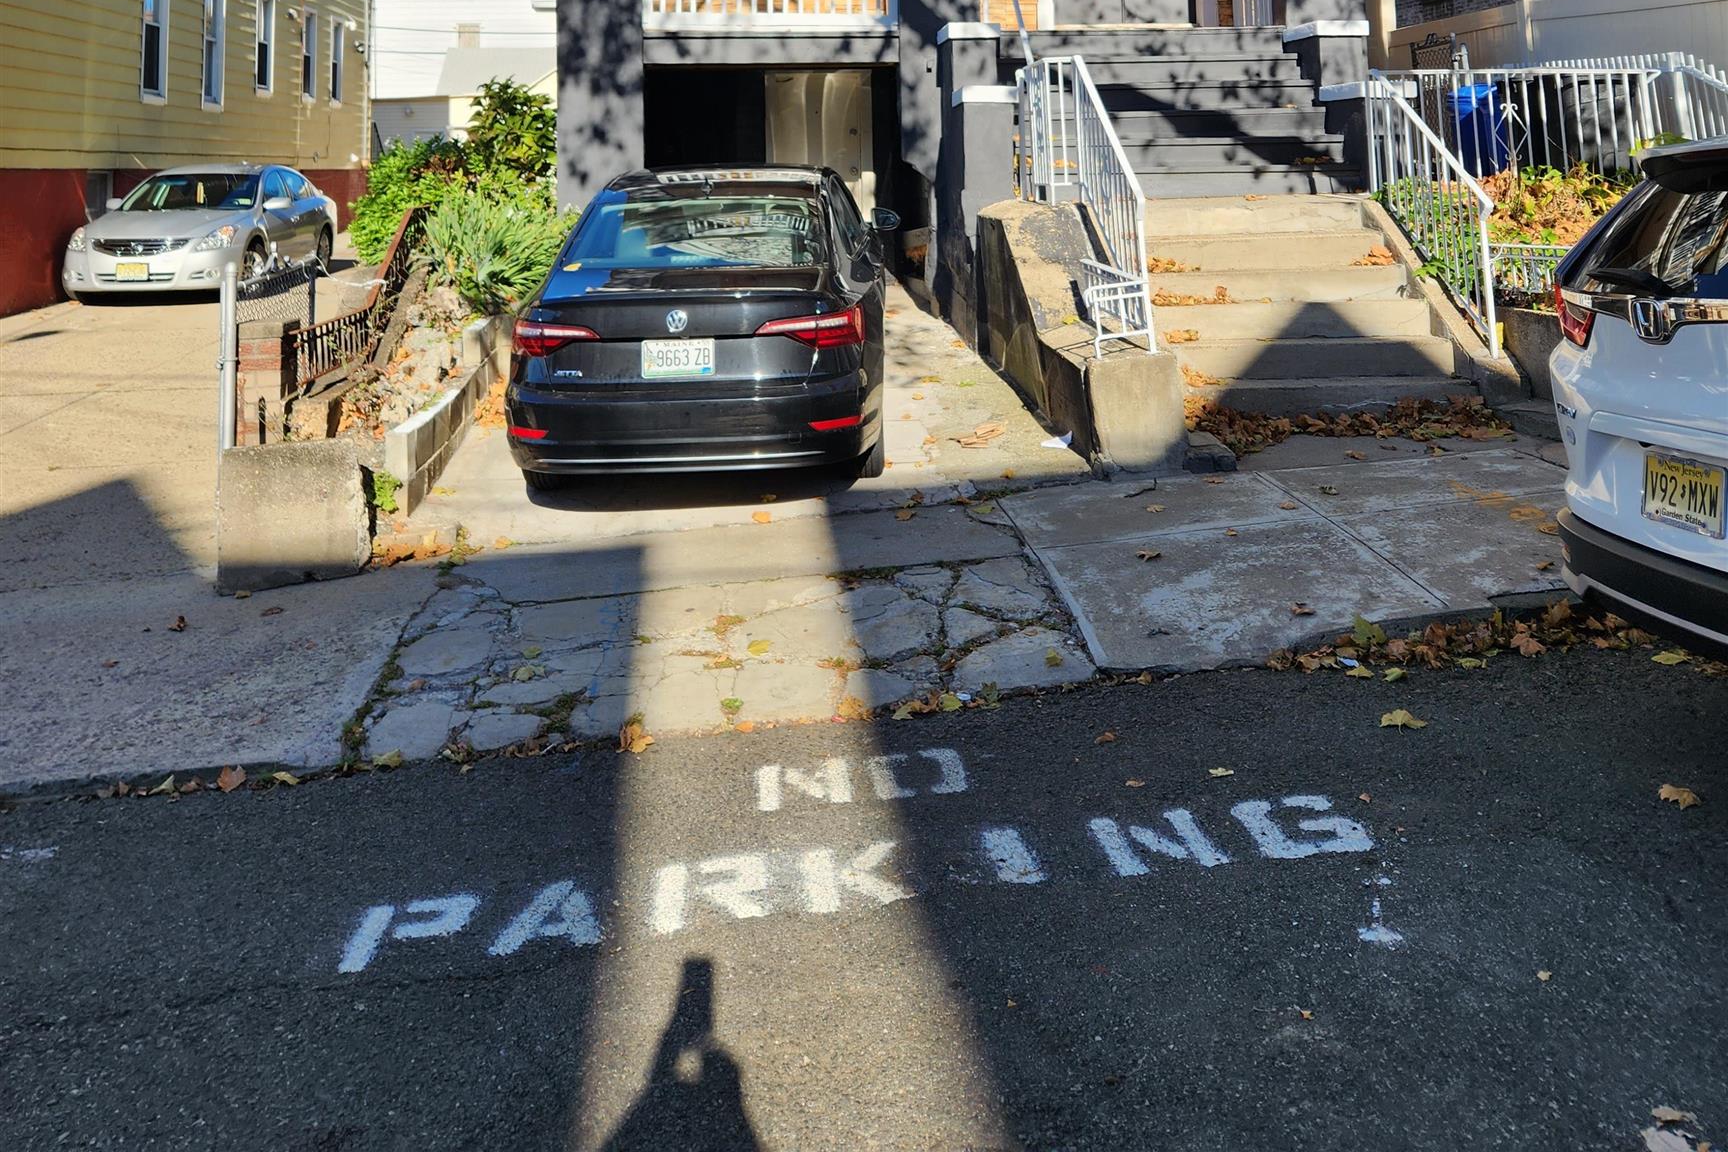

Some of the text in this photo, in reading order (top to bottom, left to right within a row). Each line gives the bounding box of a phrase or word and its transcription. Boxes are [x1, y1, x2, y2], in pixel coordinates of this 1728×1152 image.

[656, 349, 690, 367] 9663
[1664, 460, 1680, 473] New
[1681, 464, 1704, 480] Jersey
[1650, 471, 1719, 518] V92 MXW
[1661, 508, 1684, 520] Garden
[1685, 514, 1705, 527] State
[754, 747, 969, 811] NO
